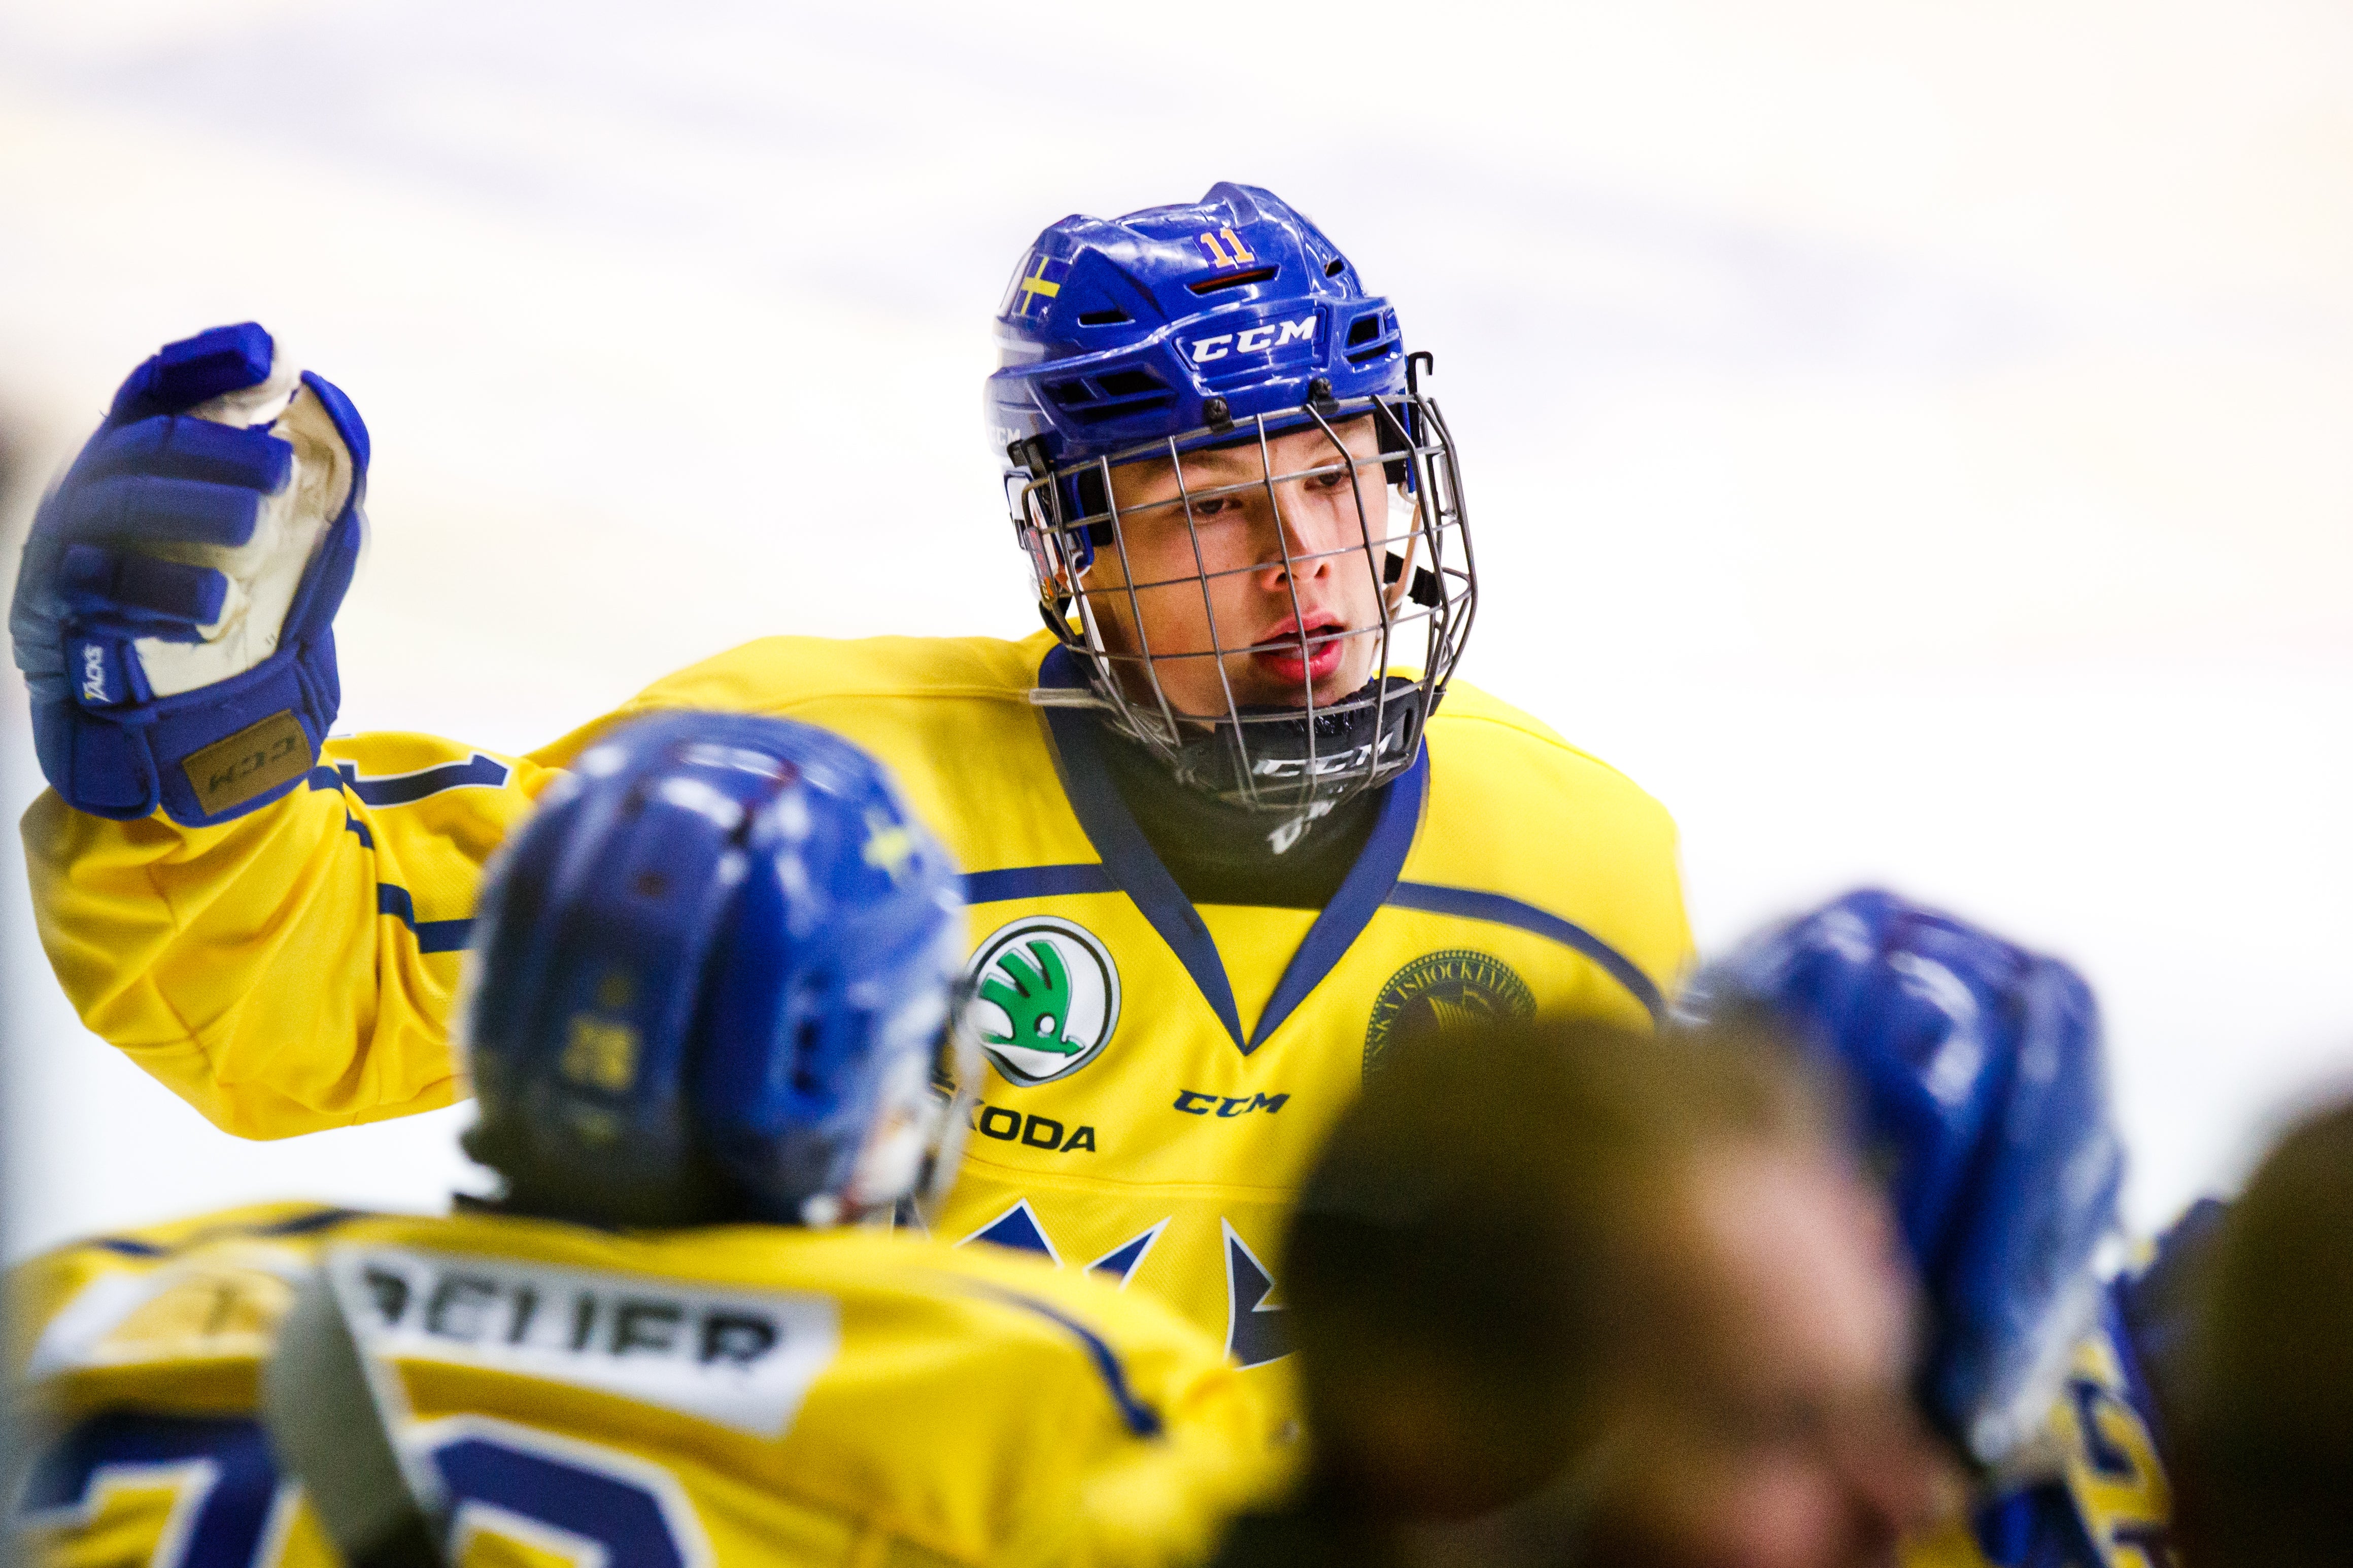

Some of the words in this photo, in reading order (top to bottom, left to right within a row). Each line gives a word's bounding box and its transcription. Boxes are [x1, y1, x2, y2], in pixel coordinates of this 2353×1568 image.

[1200, 228, 1255, 268] 11
[1192, 315, 1317, 363] CCM
[1173, 1089, 1290, 1117] CCM
